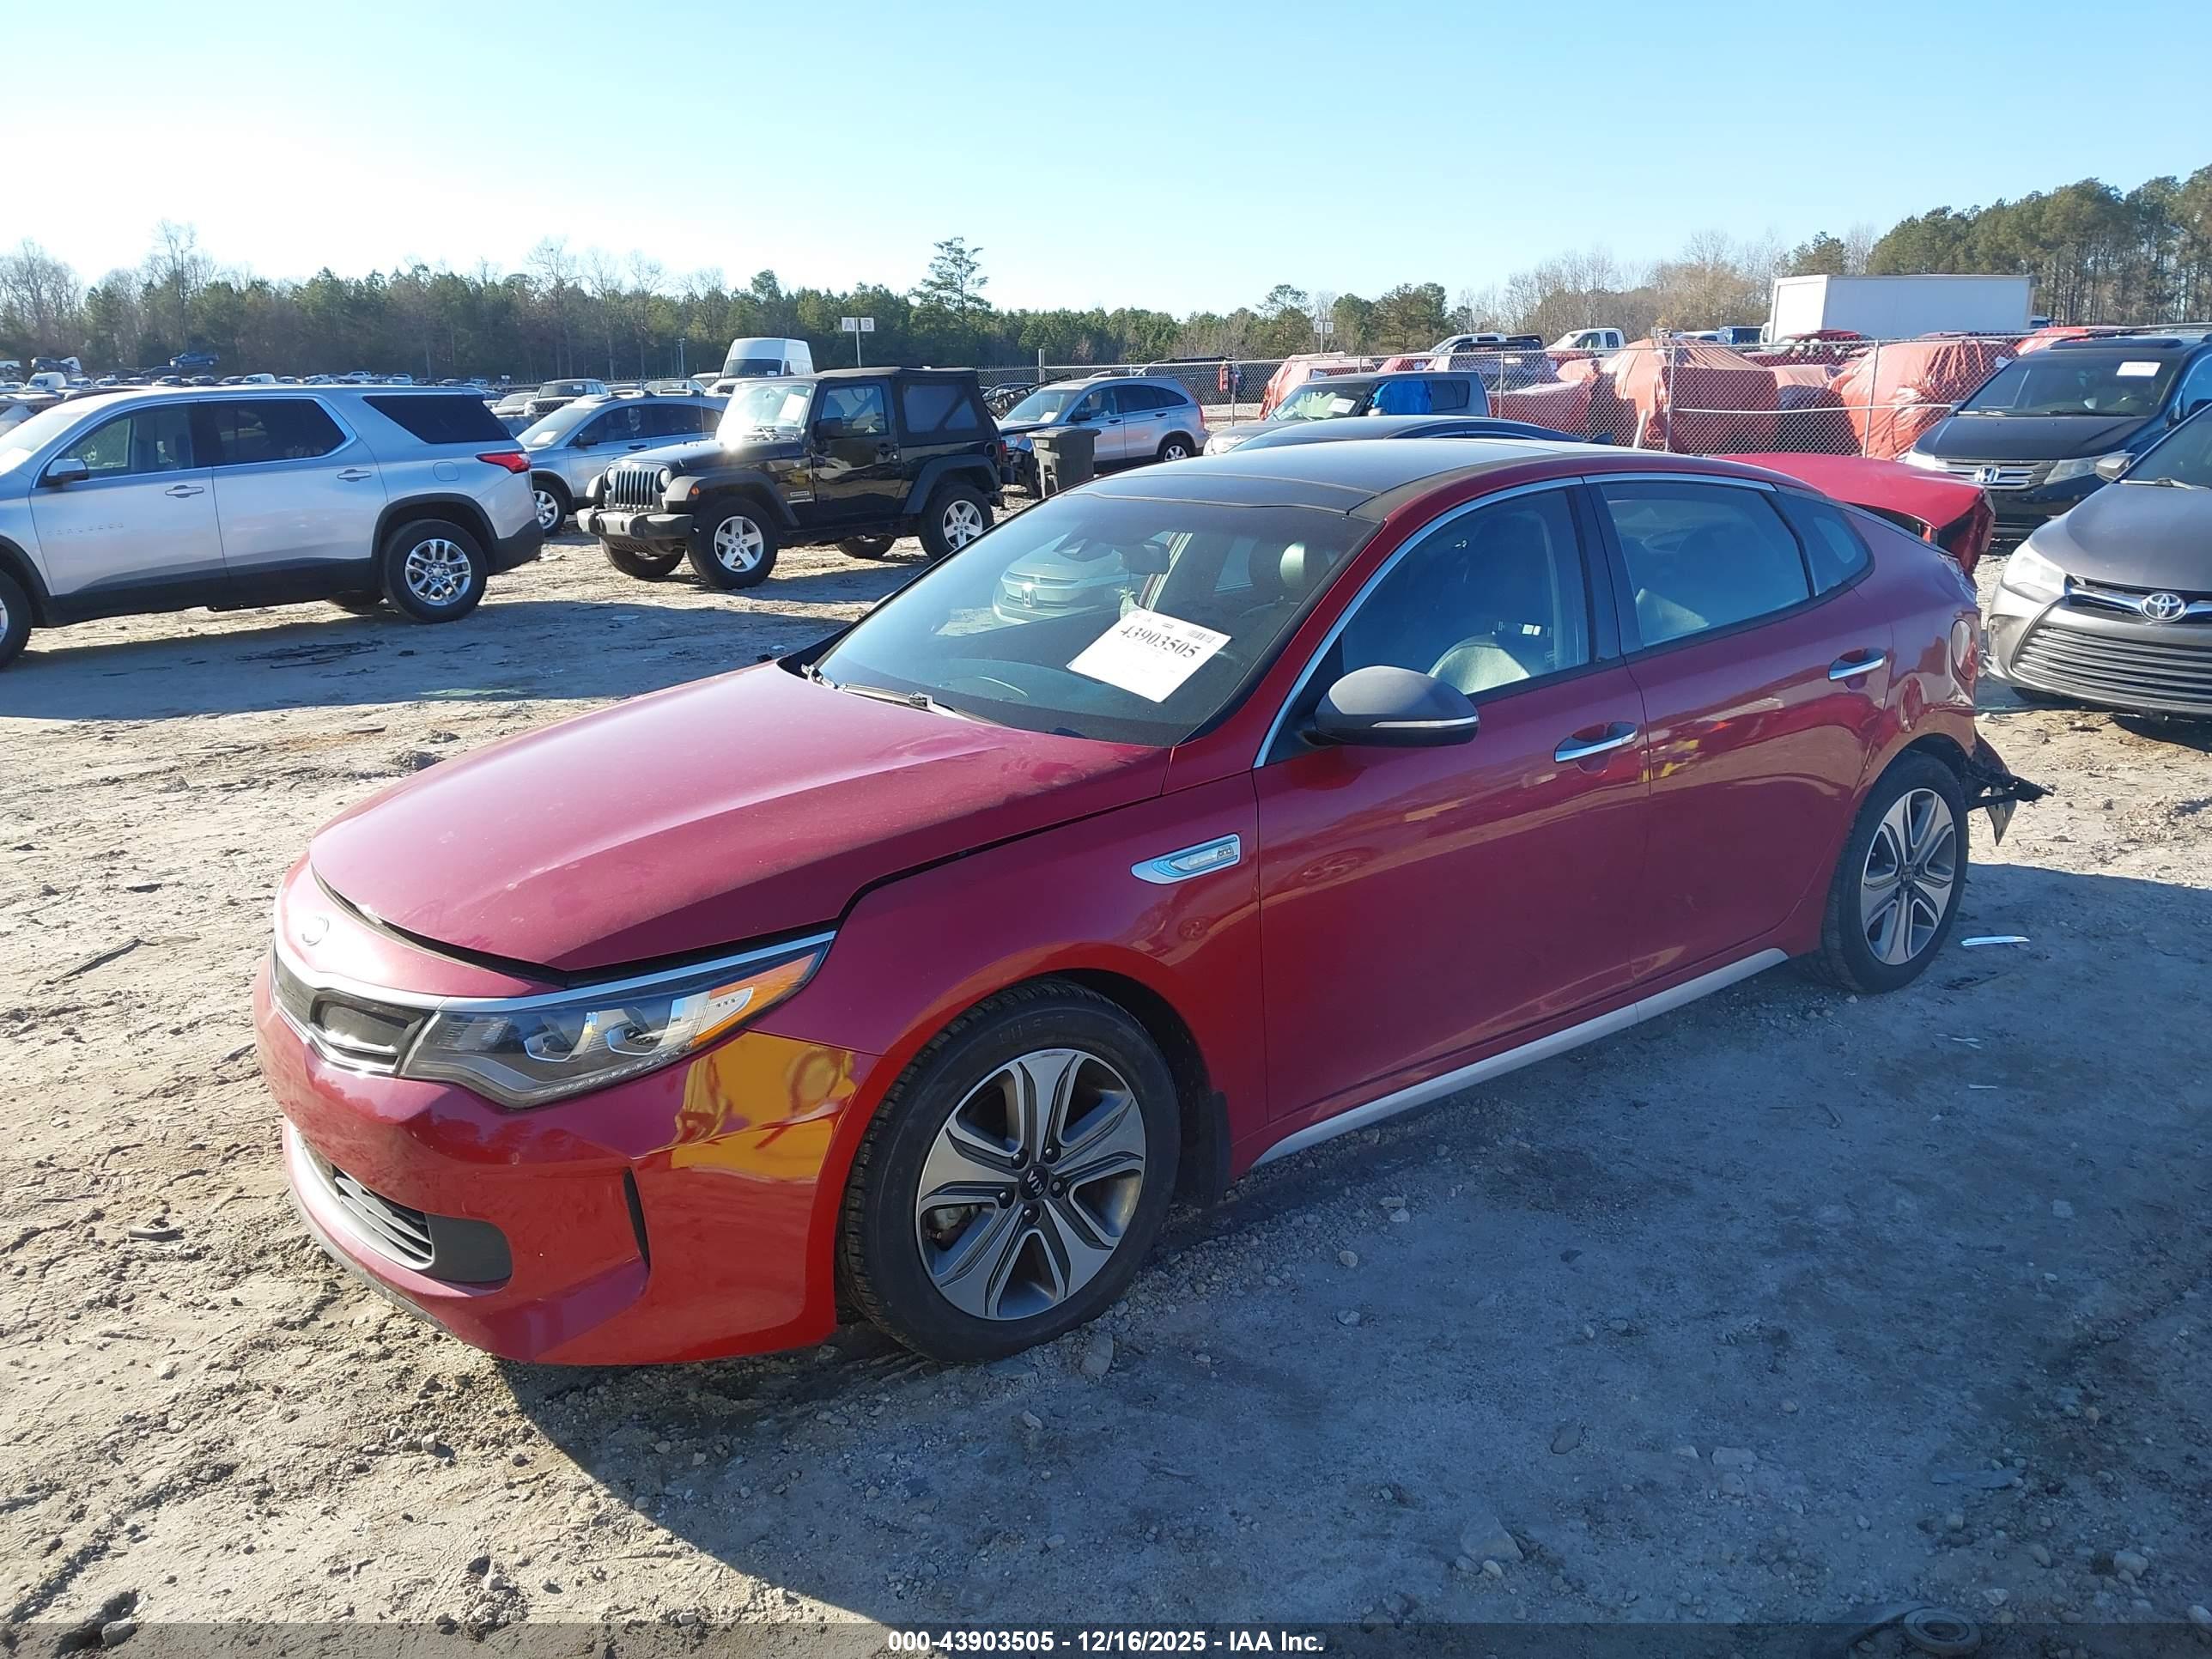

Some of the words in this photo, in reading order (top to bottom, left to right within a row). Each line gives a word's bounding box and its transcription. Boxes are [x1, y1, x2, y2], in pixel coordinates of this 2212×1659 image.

[844, 319, 854, 330] A
[864, 319, 872, 330] B
[1121, 625, 1201, 659] 43903505
[1026, 1170, 1045, 1196] KIA
